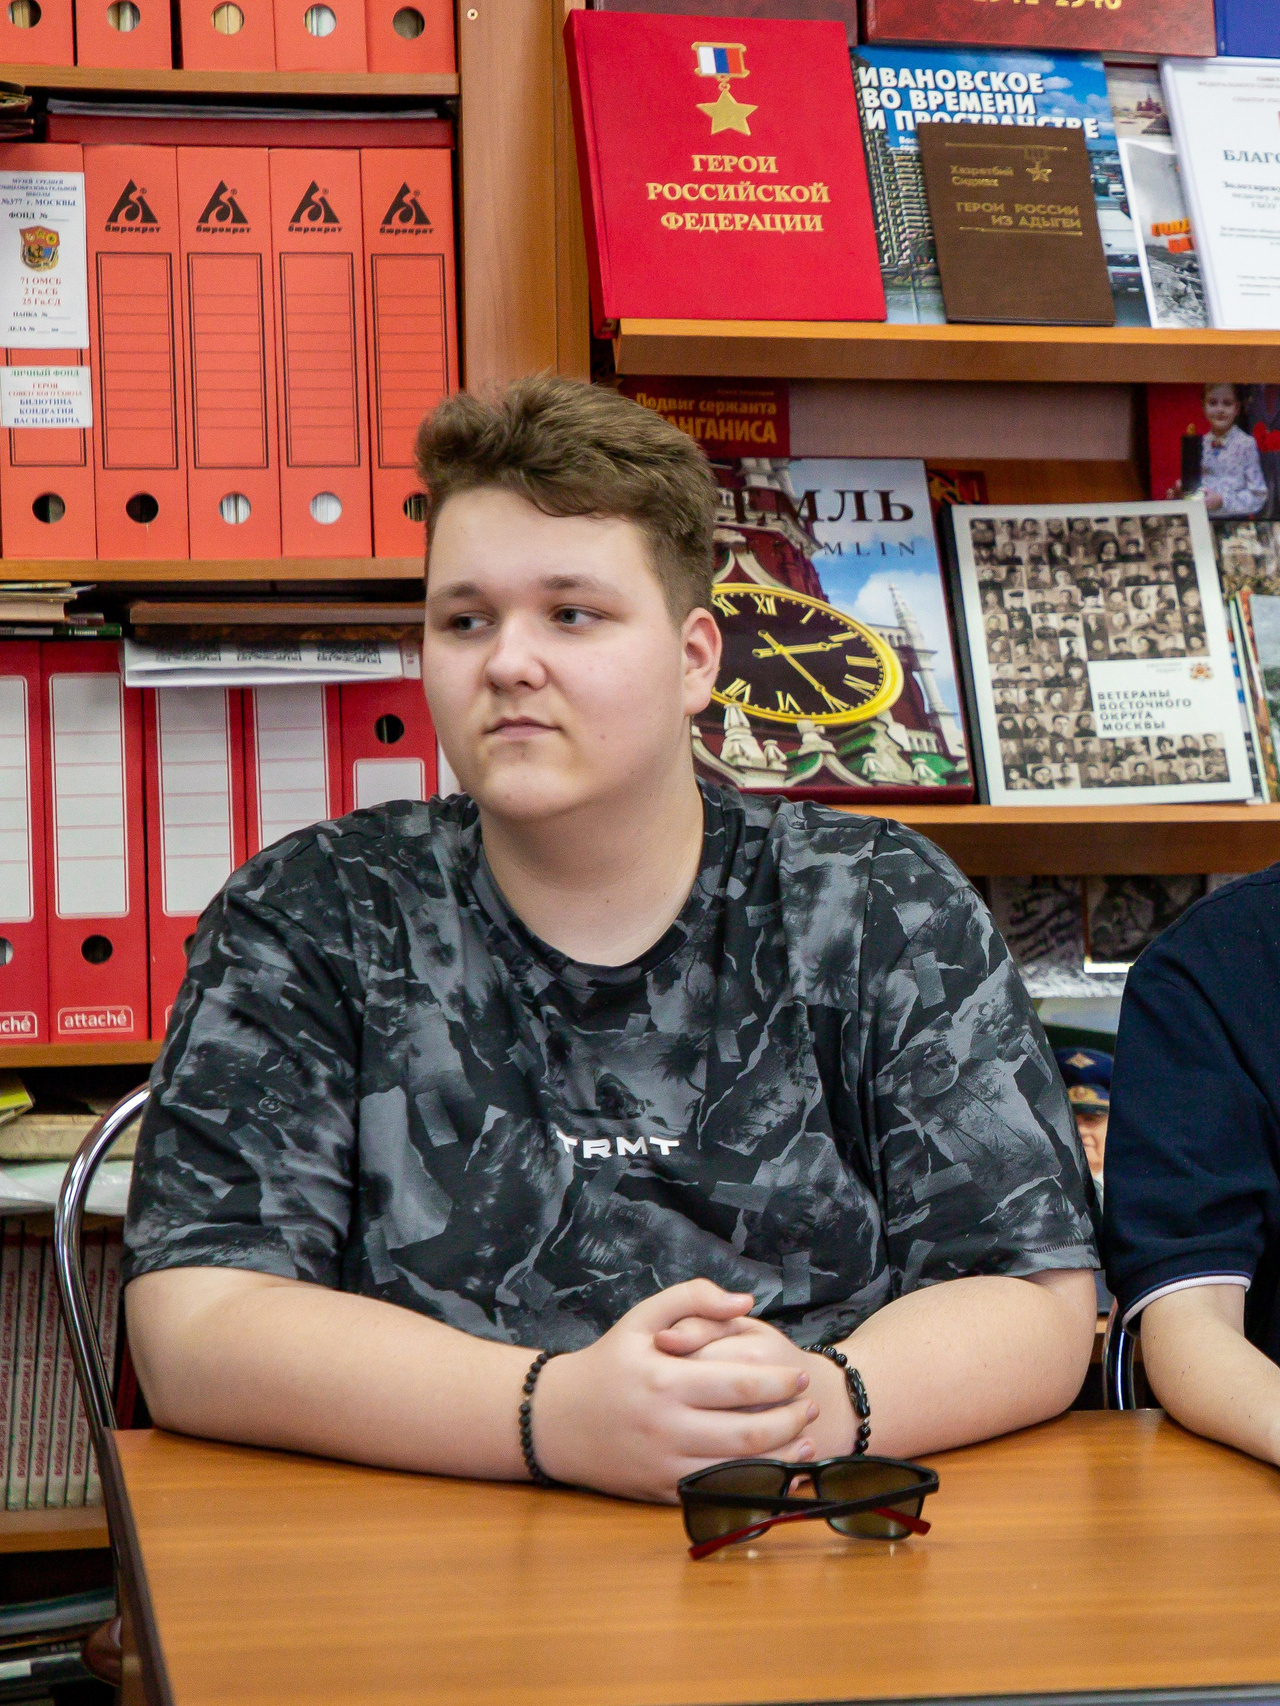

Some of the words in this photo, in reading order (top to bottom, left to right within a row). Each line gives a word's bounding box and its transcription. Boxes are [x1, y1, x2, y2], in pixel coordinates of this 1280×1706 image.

[858, 66, 1044, 94] ИВАНОВСКОЕ
[861, 88, 902, 110] ВО
[910, 90, 1038, 115] ВРЕМЕНИ
[866, 109, 886, 131] И
[691, 154, 778, 174] ГЕРОИ
[645, 181, 830, 204] РОССИЙСКОЙ
[956, 201, 1004, 213] ГЕРОИ
[1014, 203, 1080, 216] РОССИИ
[660, 211, 824, 235] ФЕДЕРАЦИИ
[991, 215, 1013, 226] ИЗ
[1018, 216, 1081, 229] АДЫГЕИ
[1098, 689, 1170, 700] ВЕТЕРАНЫ
[1099, 698, 1192, 710] ВОСТОЧНОГО
[1100, 711, 1153, 721] ОКРУГА
[1102, 721, 1166, 731] МОСКВЫ
[64, 1009, 127, 1028] attaché
